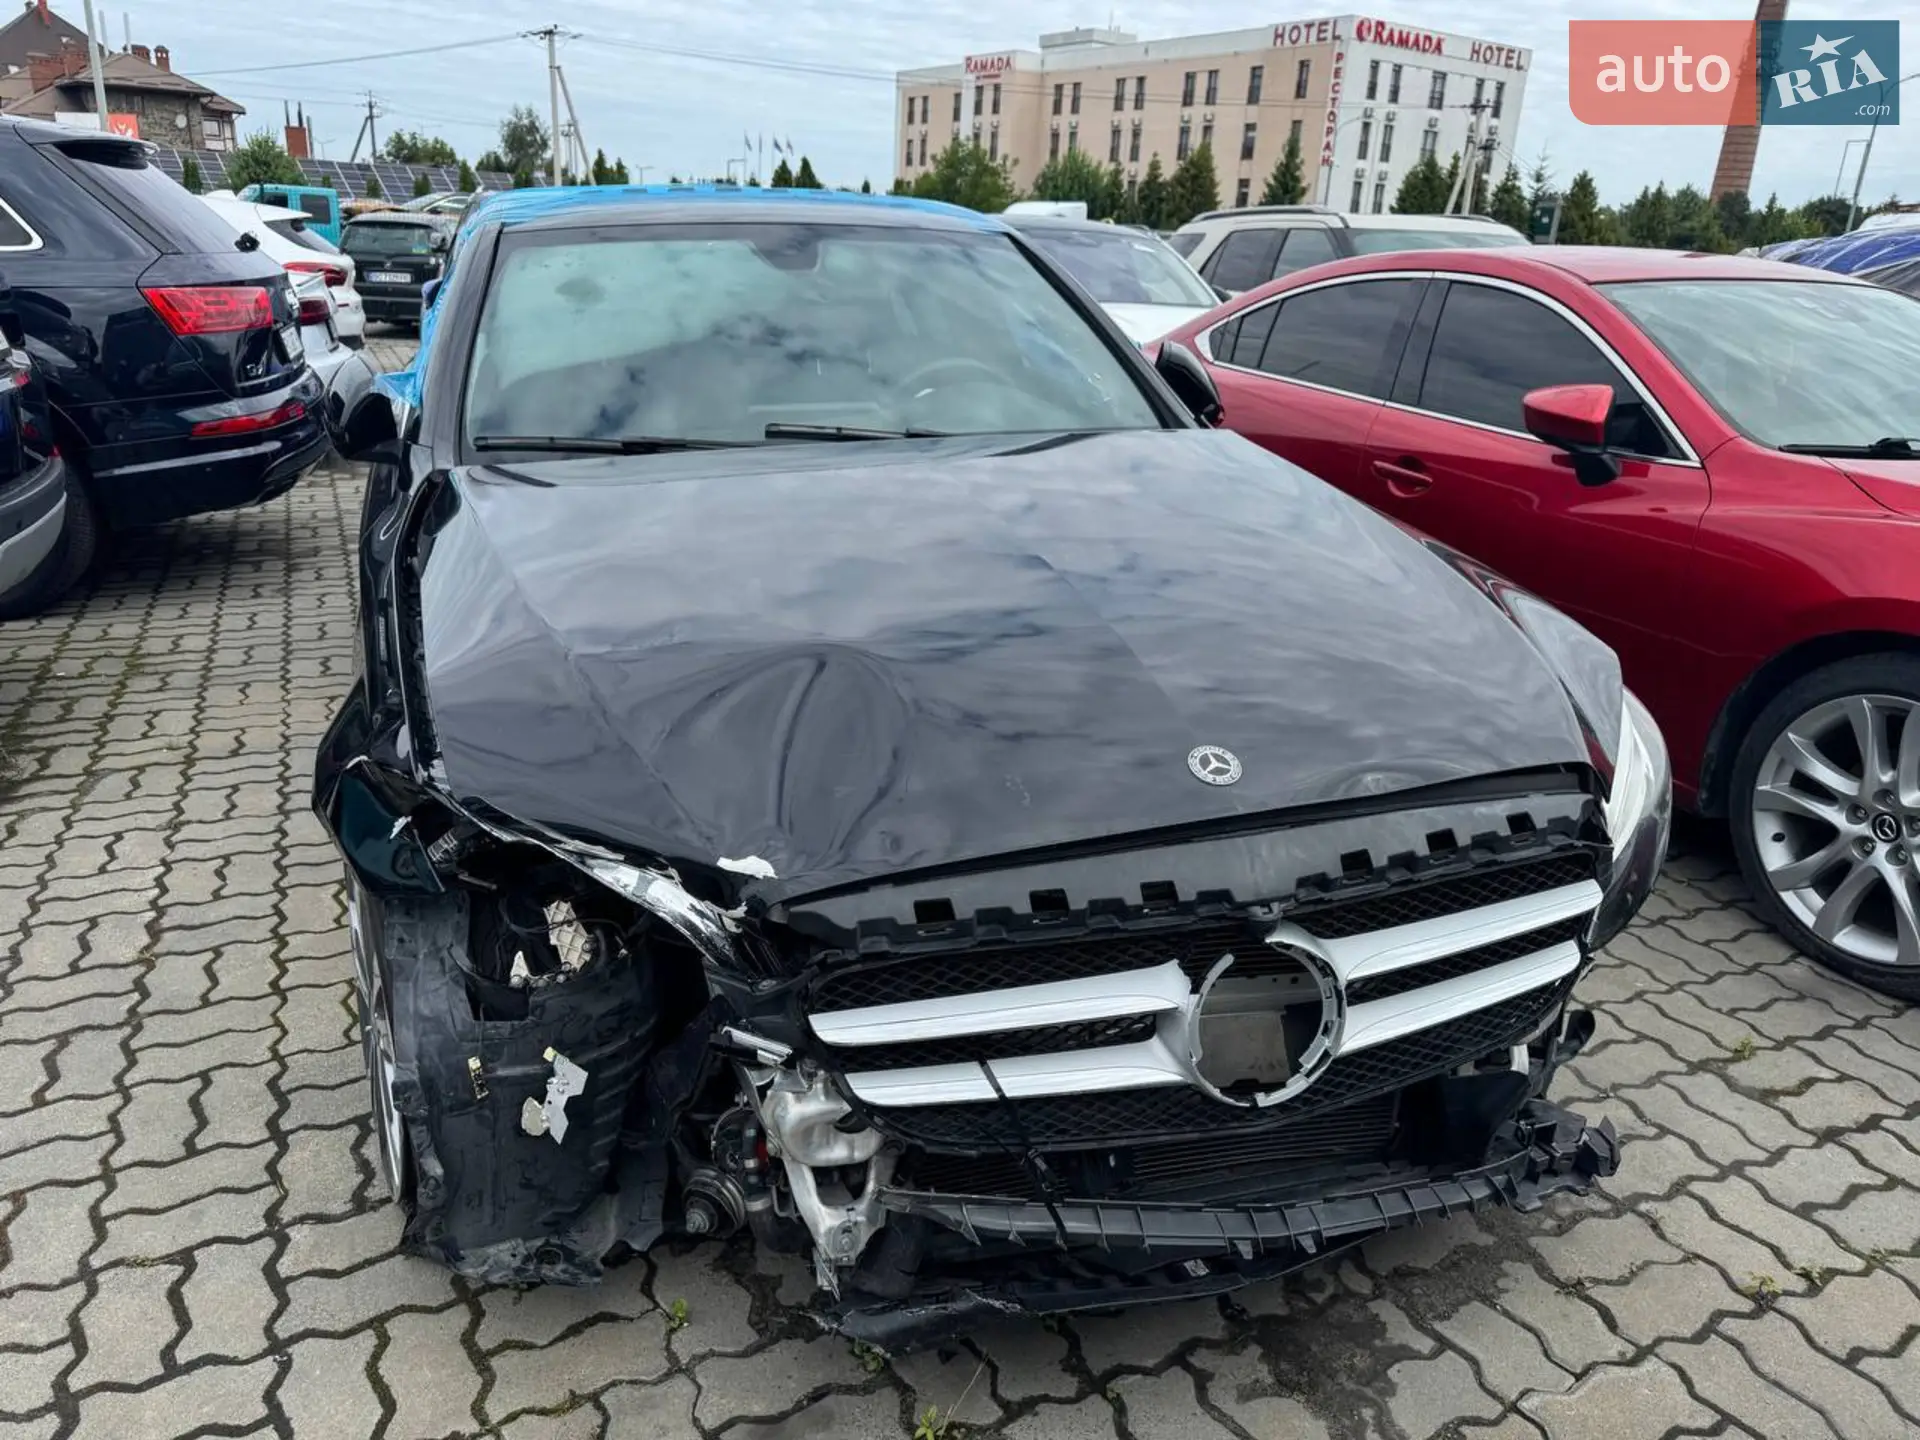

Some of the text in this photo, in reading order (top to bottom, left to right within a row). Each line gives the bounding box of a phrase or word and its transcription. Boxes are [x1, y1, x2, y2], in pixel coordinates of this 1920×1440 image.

[1273, 19, 1342, 46] HOTEL
[1373, 20, 1524, 71] RAMADA HOTEL
[965, 55, 1012, 74] RAMADA
[1321, 52, 1344, 167] РЕСТОРАН
